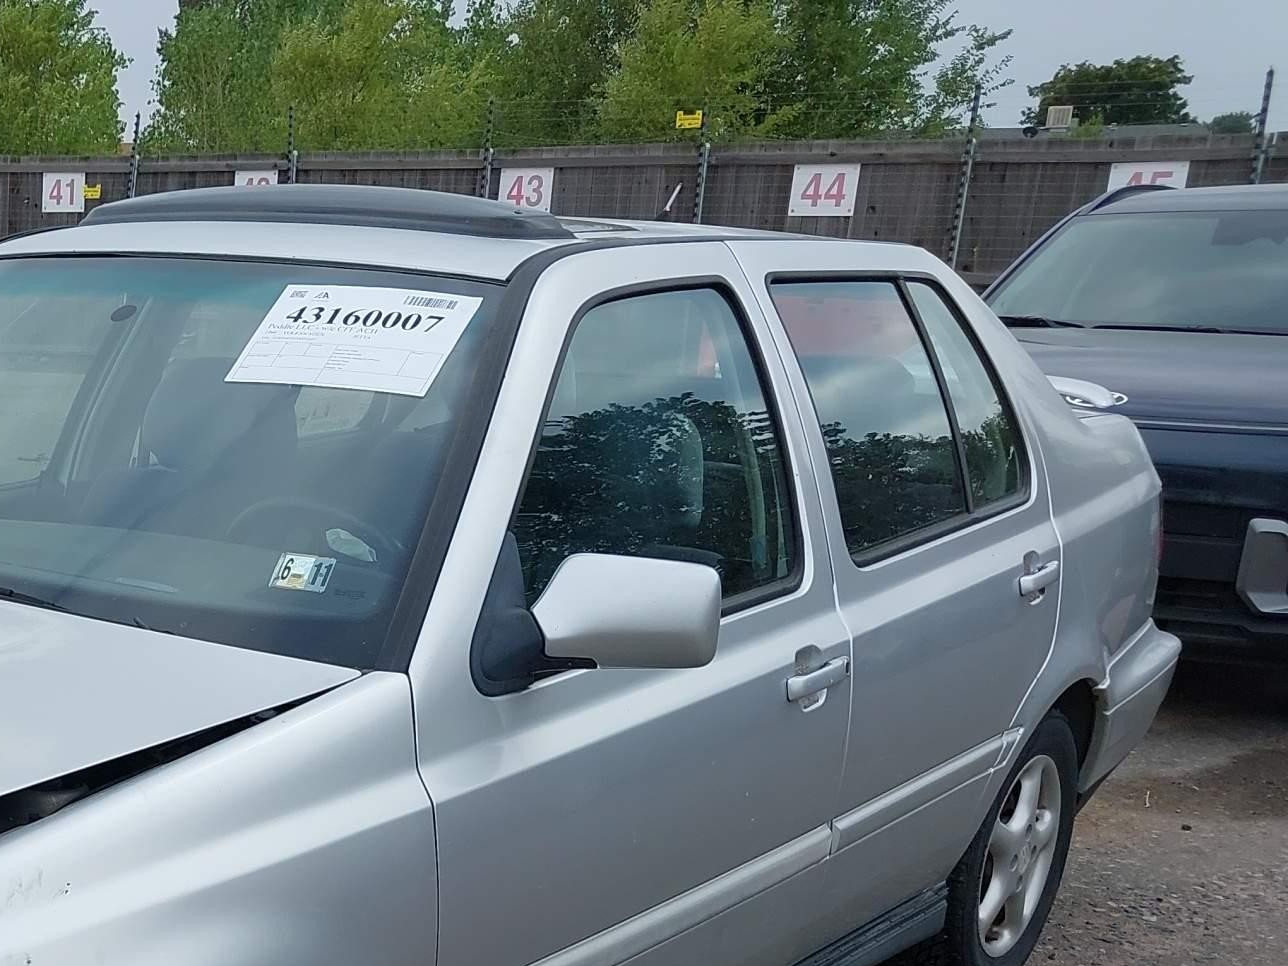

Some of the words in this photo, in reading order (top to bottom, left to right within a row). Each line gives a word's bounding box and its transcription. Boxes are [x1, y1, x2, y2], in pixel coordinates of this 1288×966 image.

[48, 178, 75, 206] 41
[506, 174, 544, 207] 43
[800, 172, 846, 208] 44
[286, 305, 445, 333] 43160007
[281, 558, 294, 580] 6
[310, 562, 333, 587] 11
